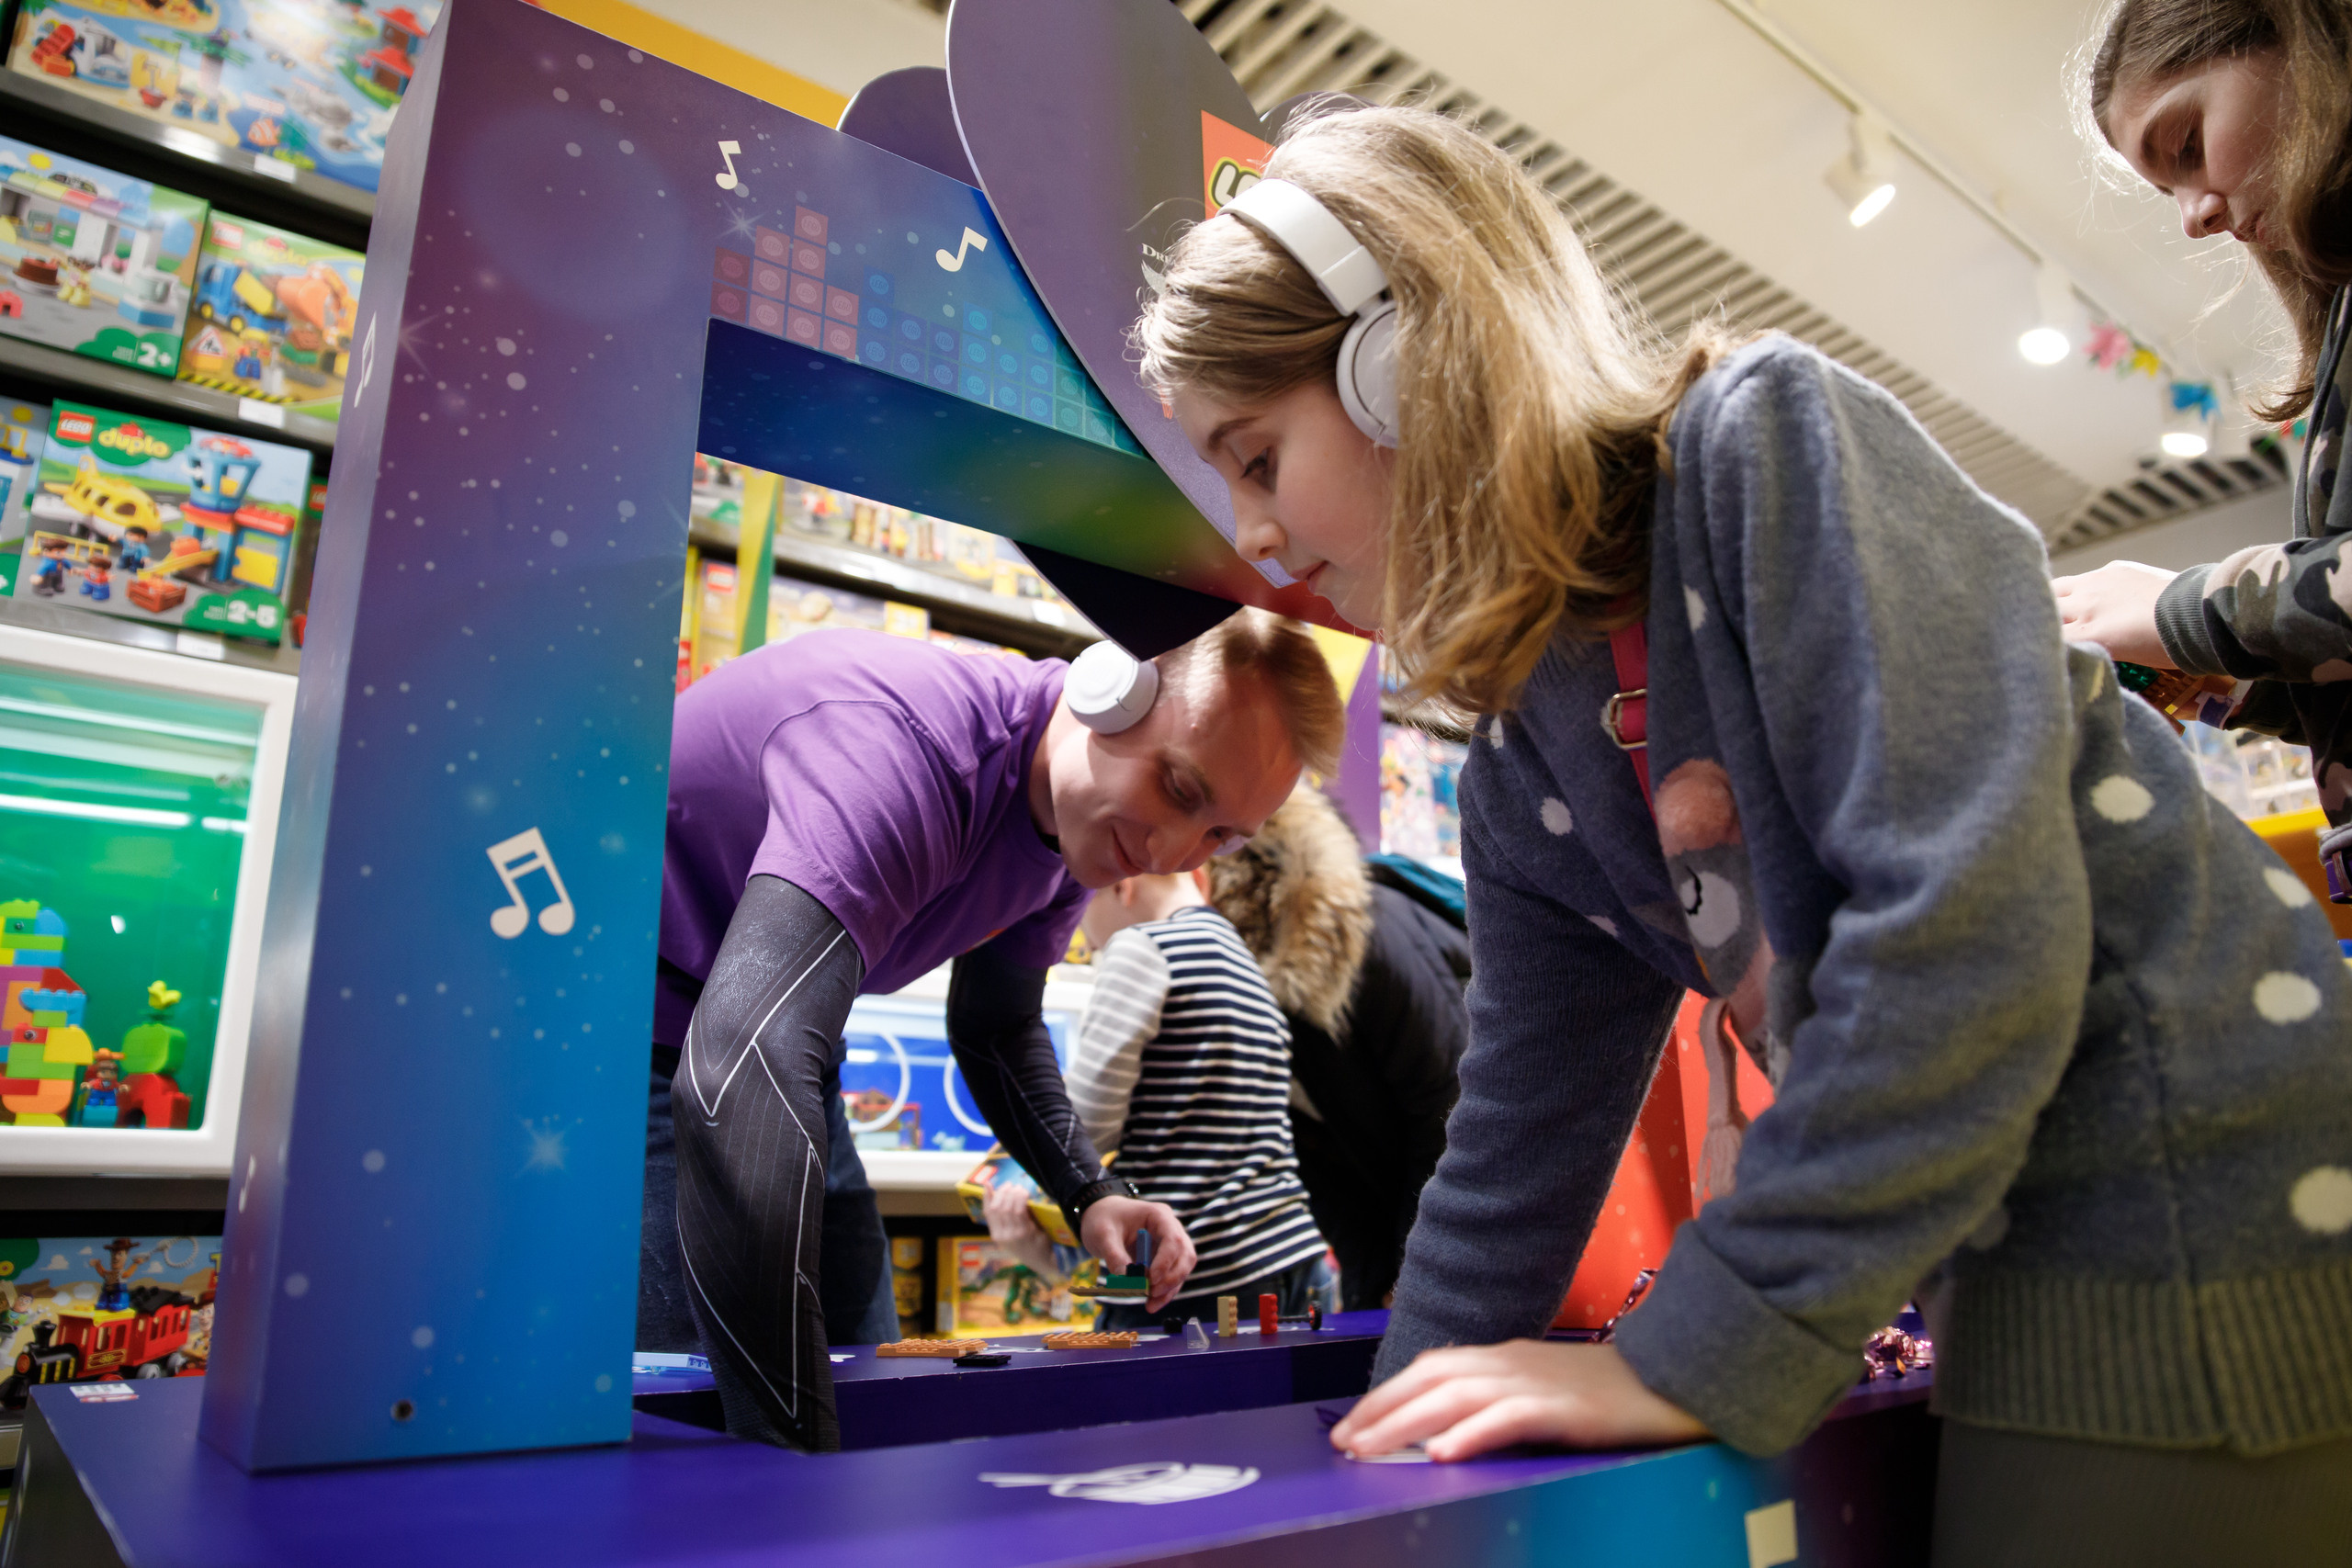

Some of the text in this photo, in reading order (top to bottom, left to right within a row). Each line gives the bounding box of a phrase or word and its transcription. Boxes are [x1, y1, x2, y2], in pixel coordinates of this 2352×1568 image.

[137, 342, 172, 367] 2+
[60, 418, 170, 457] LEGO duplo
[227, 599, 277, 628] 2-5
